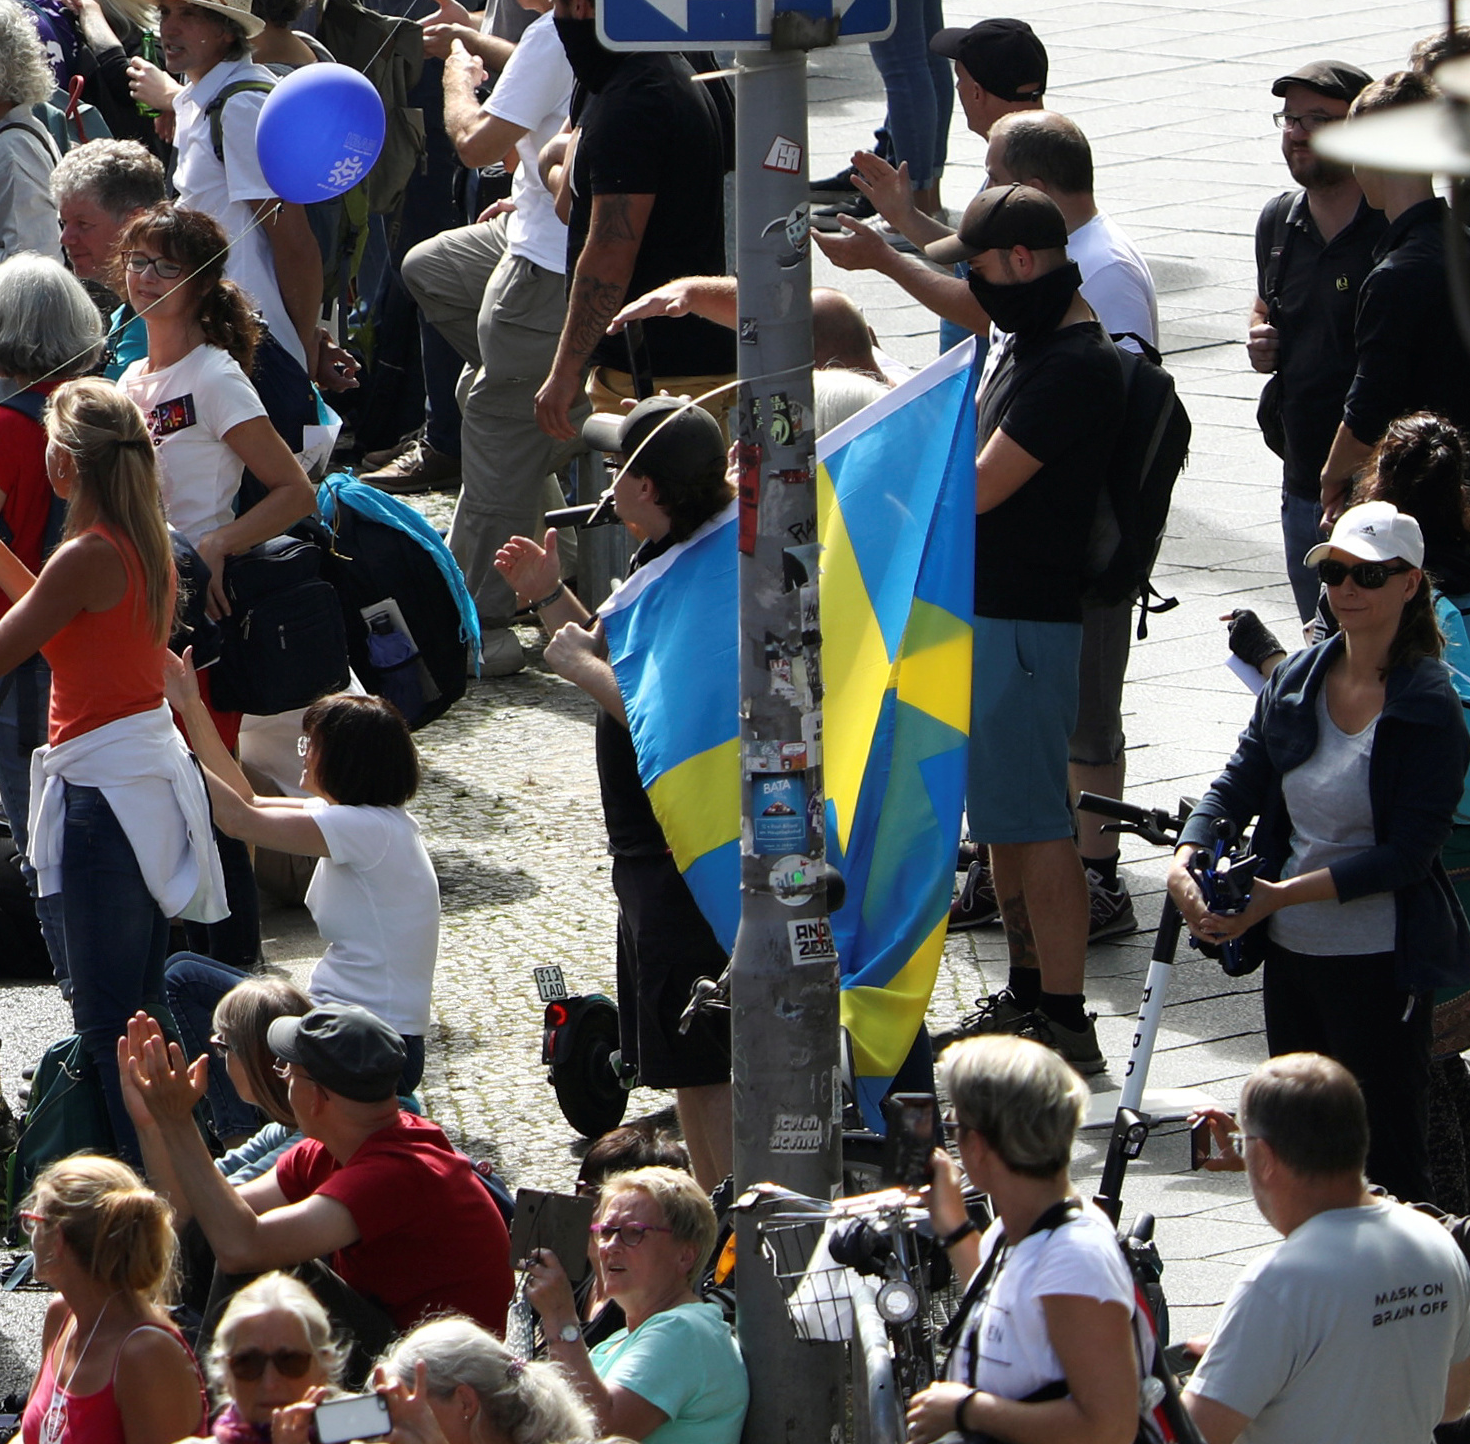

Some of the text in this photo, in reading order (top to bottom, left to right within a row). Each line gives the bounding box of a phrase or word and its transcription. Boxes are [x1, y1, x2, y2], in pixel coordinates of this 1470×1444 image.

[763, 778, 791, 794] BATA
[537, 968, 560, 983] 311
[1375, 1282, 1444, 1307] MASK ON
[1372, 1300, 1449, 1328] BRAIN OFF
